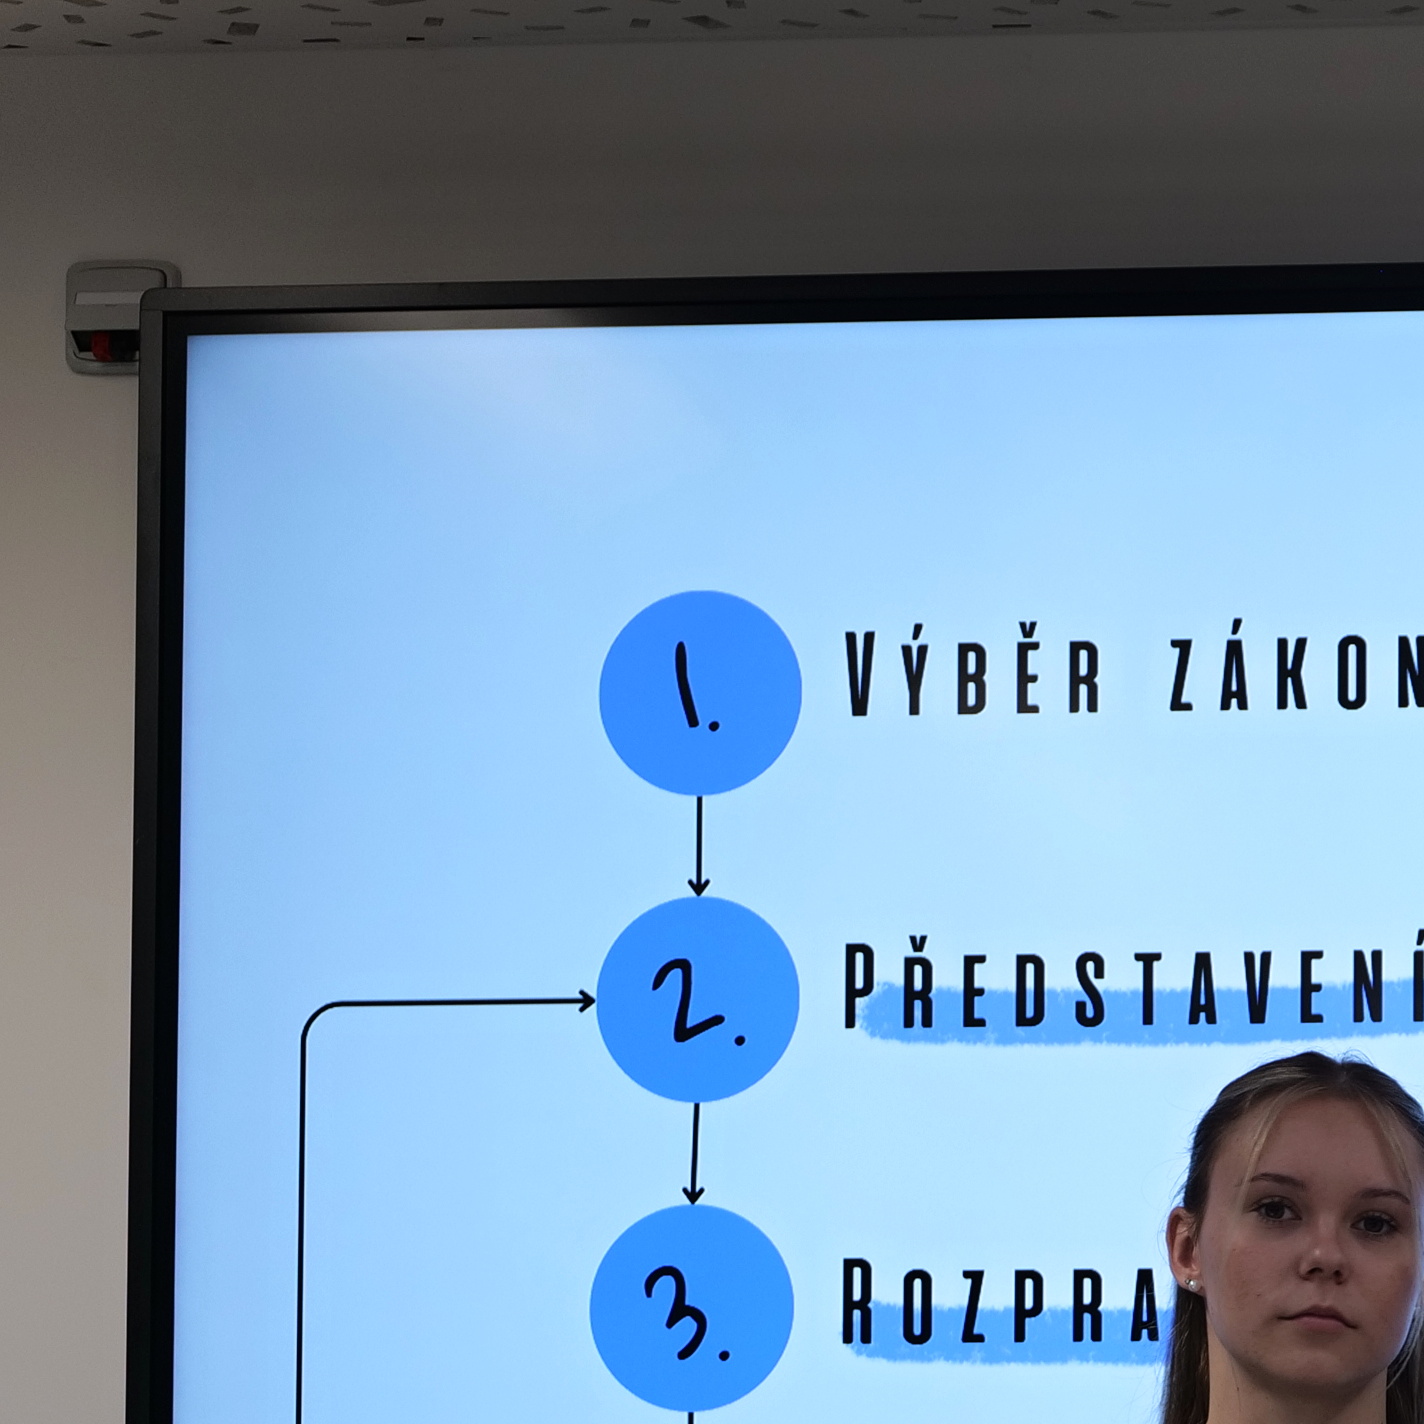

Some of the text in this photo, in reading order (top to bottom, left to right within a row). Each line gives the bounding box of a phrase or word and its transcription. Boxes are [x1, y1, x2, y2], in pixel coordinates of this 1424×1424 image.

[675, 640, 720, 733] 1.
[845, 621, 1099, 717] VÝBĚR
[651, 957, 746, 1047] 2.
[643, 1258, 1160, 1362] 3. ROZPRA
